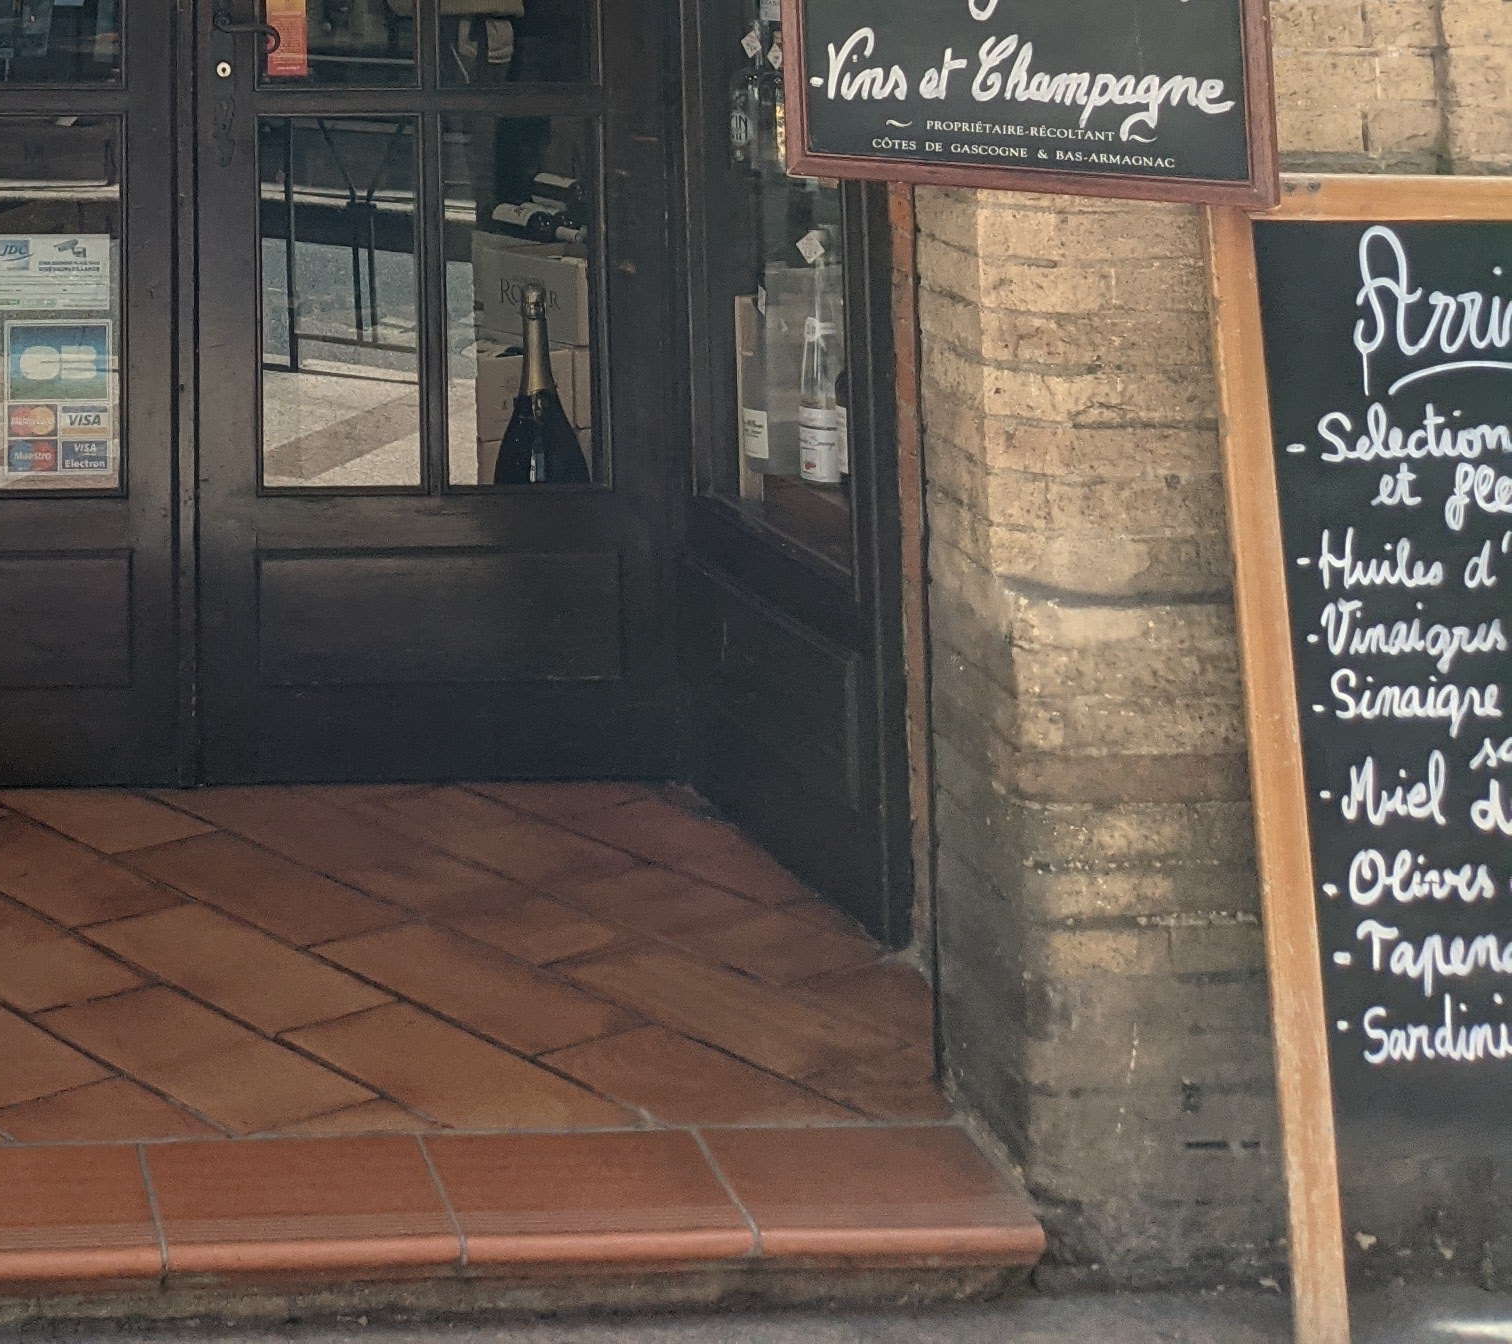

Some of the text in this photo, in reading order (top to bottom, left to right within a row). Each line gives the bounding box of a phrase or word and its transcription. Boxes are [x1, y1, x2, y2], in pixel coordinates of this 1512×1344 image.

[918, 46, 968, 101] et
[970, 33, 1236, 143] Champagne
[871, 136, 1176, 169] CÔTES DE GASCOGNE & BAS-ARMAGNAC
[68, 414, 102, 426] VISA
[64, 459, 105, 468] Electron
[74, 443, 97, 452] VISA
[1370, 462, 1422, 507] et
[1318, 526, 1444, 590] Huiles
[1340, 749, 1512, 836] Miel d
[1348, 848, 1495, 905] Olives
